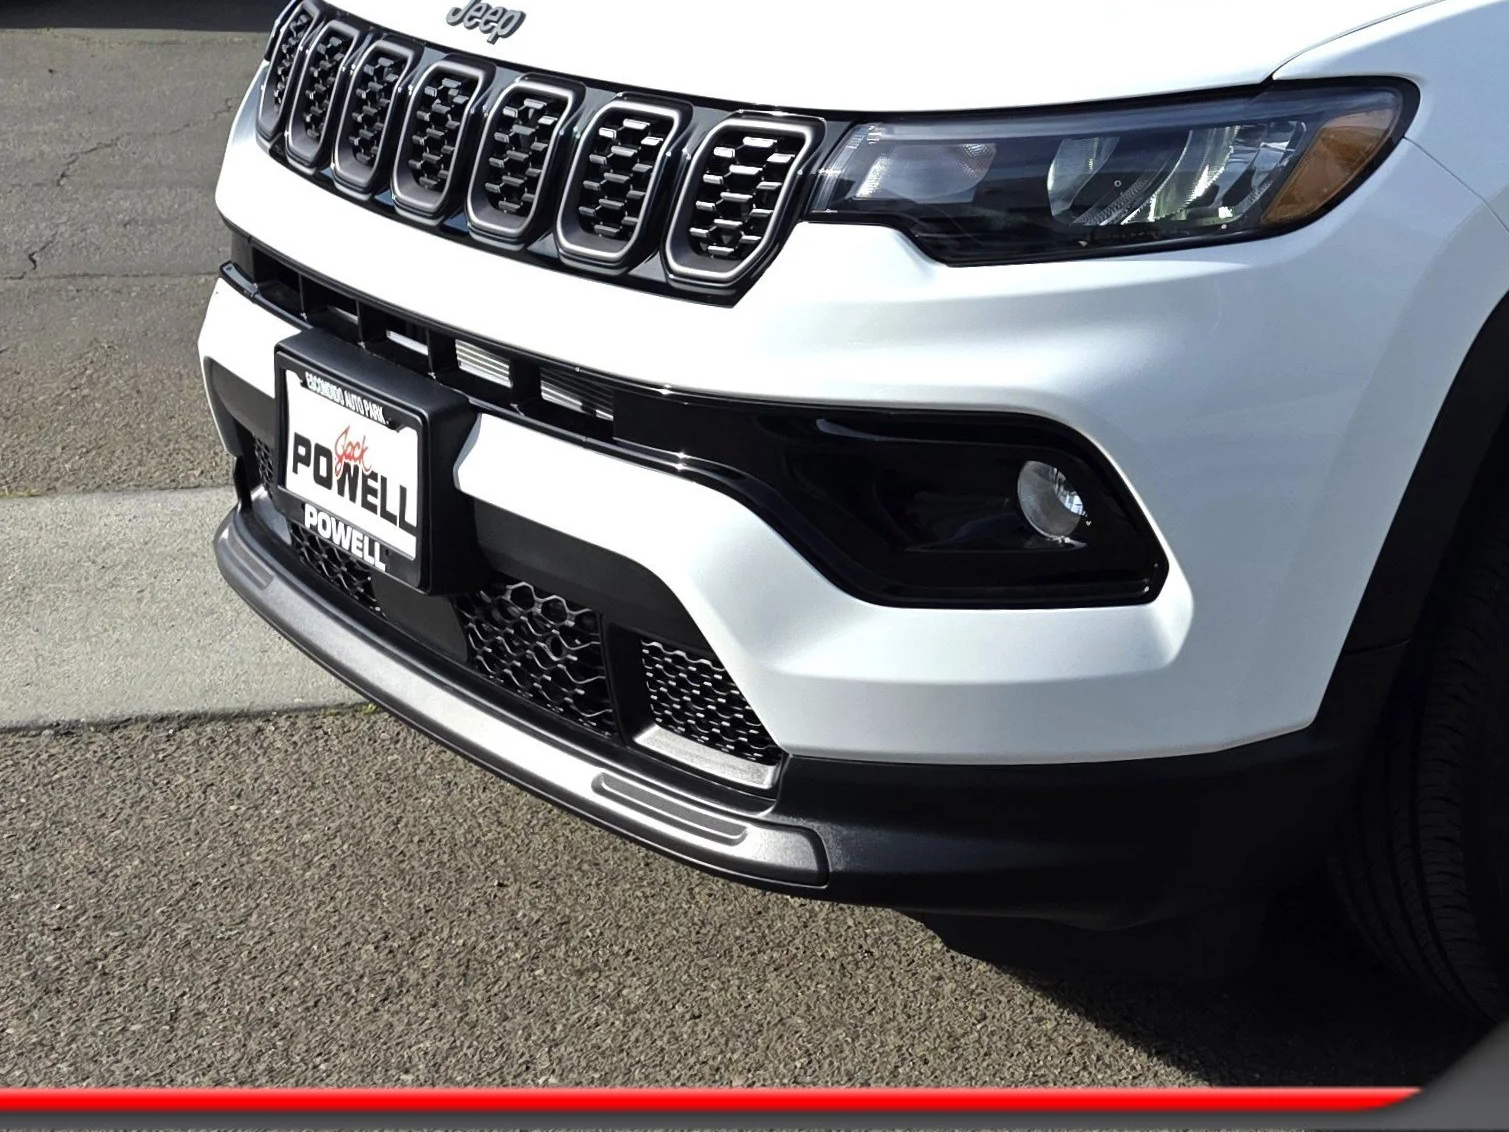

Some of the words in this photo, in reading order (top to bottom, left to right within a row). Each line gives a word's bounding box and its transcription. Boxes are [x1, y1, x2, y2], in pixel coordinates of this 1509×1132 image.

[304, 371, 345, 407] ESCONDIDO
[343, 390, 365, 415] AUTO
[362, 399, 387, 425] PARK
[334, 425, 372, 477] Jack
[292, 432, 417, 538] POWELL
[304, 502, 386, 572] POWELL
